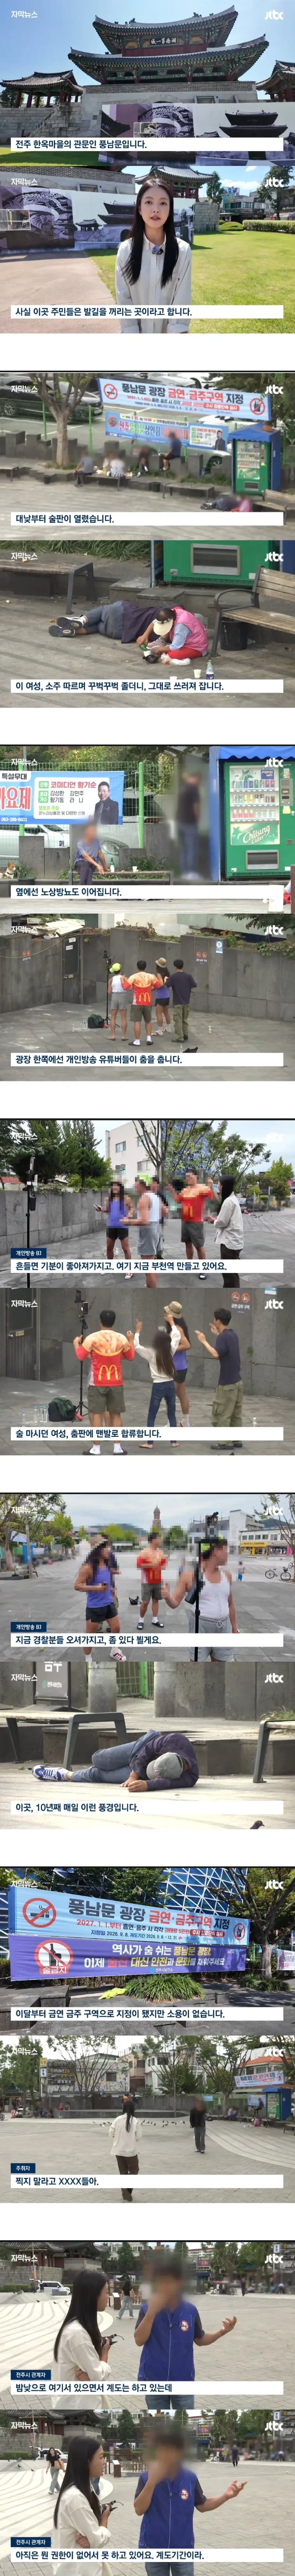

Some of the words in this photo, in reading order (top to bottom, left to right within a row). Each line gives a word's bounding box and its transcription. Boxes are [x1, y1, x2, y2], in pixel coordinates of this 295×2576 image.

[122, 383, 147, 394] 풍남문
[149, 386, 166, 397] 광장
[168, 388, 224, 403] 금연·금주구역
[226, 393, 244, 404] 지정
[243, 825, 270, 843] Chilsung
[251, 833, 266, 844] Cider
[69, 1898, 115, 1919] 풍남문
[120, 1905, 146, 1922] 광장
[149, 1910, 212, 1928] 금연·금주구역
[214, 1918, 229, 1930] 지정
[112, 1944, 142, 1955] 역사가
[144, 1945, 153, 1955] 숨
[155, 1945, 172, 1956] 쉬는
[174, 1946, 196, 1956] 풍남문
[197, 1947, 211, 1956] 광장,
[84, 1958, 105, 1968] 이제
[130, 1957, 149, 1967] 대신
[151, 1957, 174, 1966] 안전과
[175, 1957, 196, 1966] 문화를
[197, 1958, 225, 1966] 채워주세요
[43, 1966, 67, 1974] 술금지
